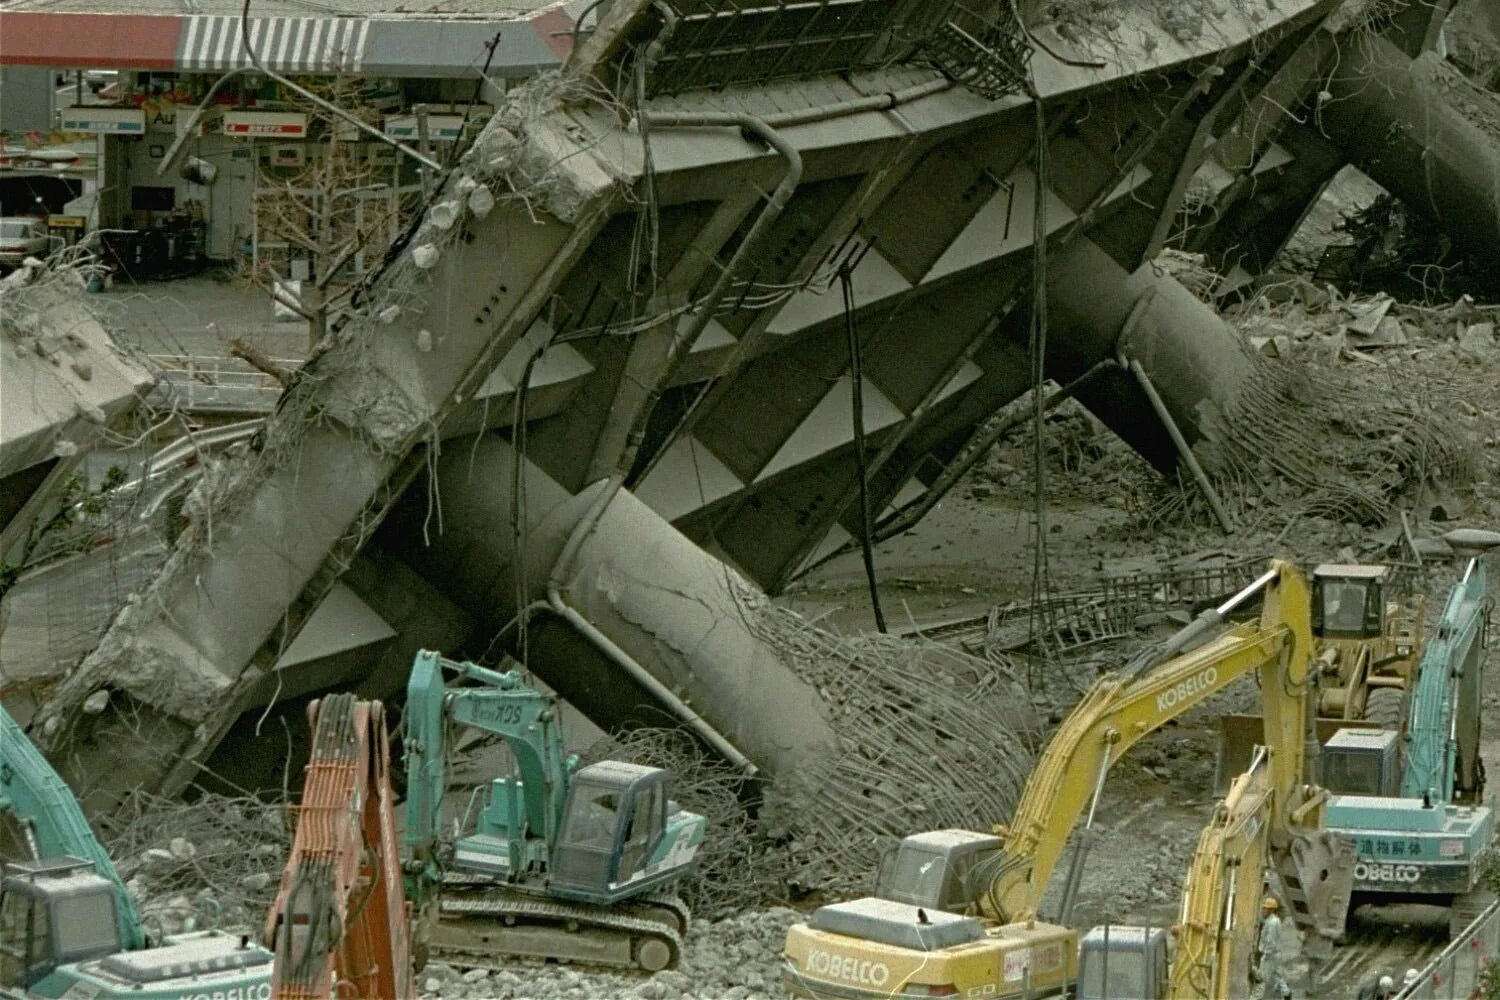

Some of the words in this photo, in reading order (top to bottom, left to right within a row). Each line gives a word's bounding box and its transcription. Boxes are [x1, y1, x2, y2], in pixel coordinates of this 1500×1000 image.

[1157, 667, 1218, 712] KOBELCO
[1354, 864, 1421, 882] OBELCO
[806, 949, 889, 987] KOBELCO
